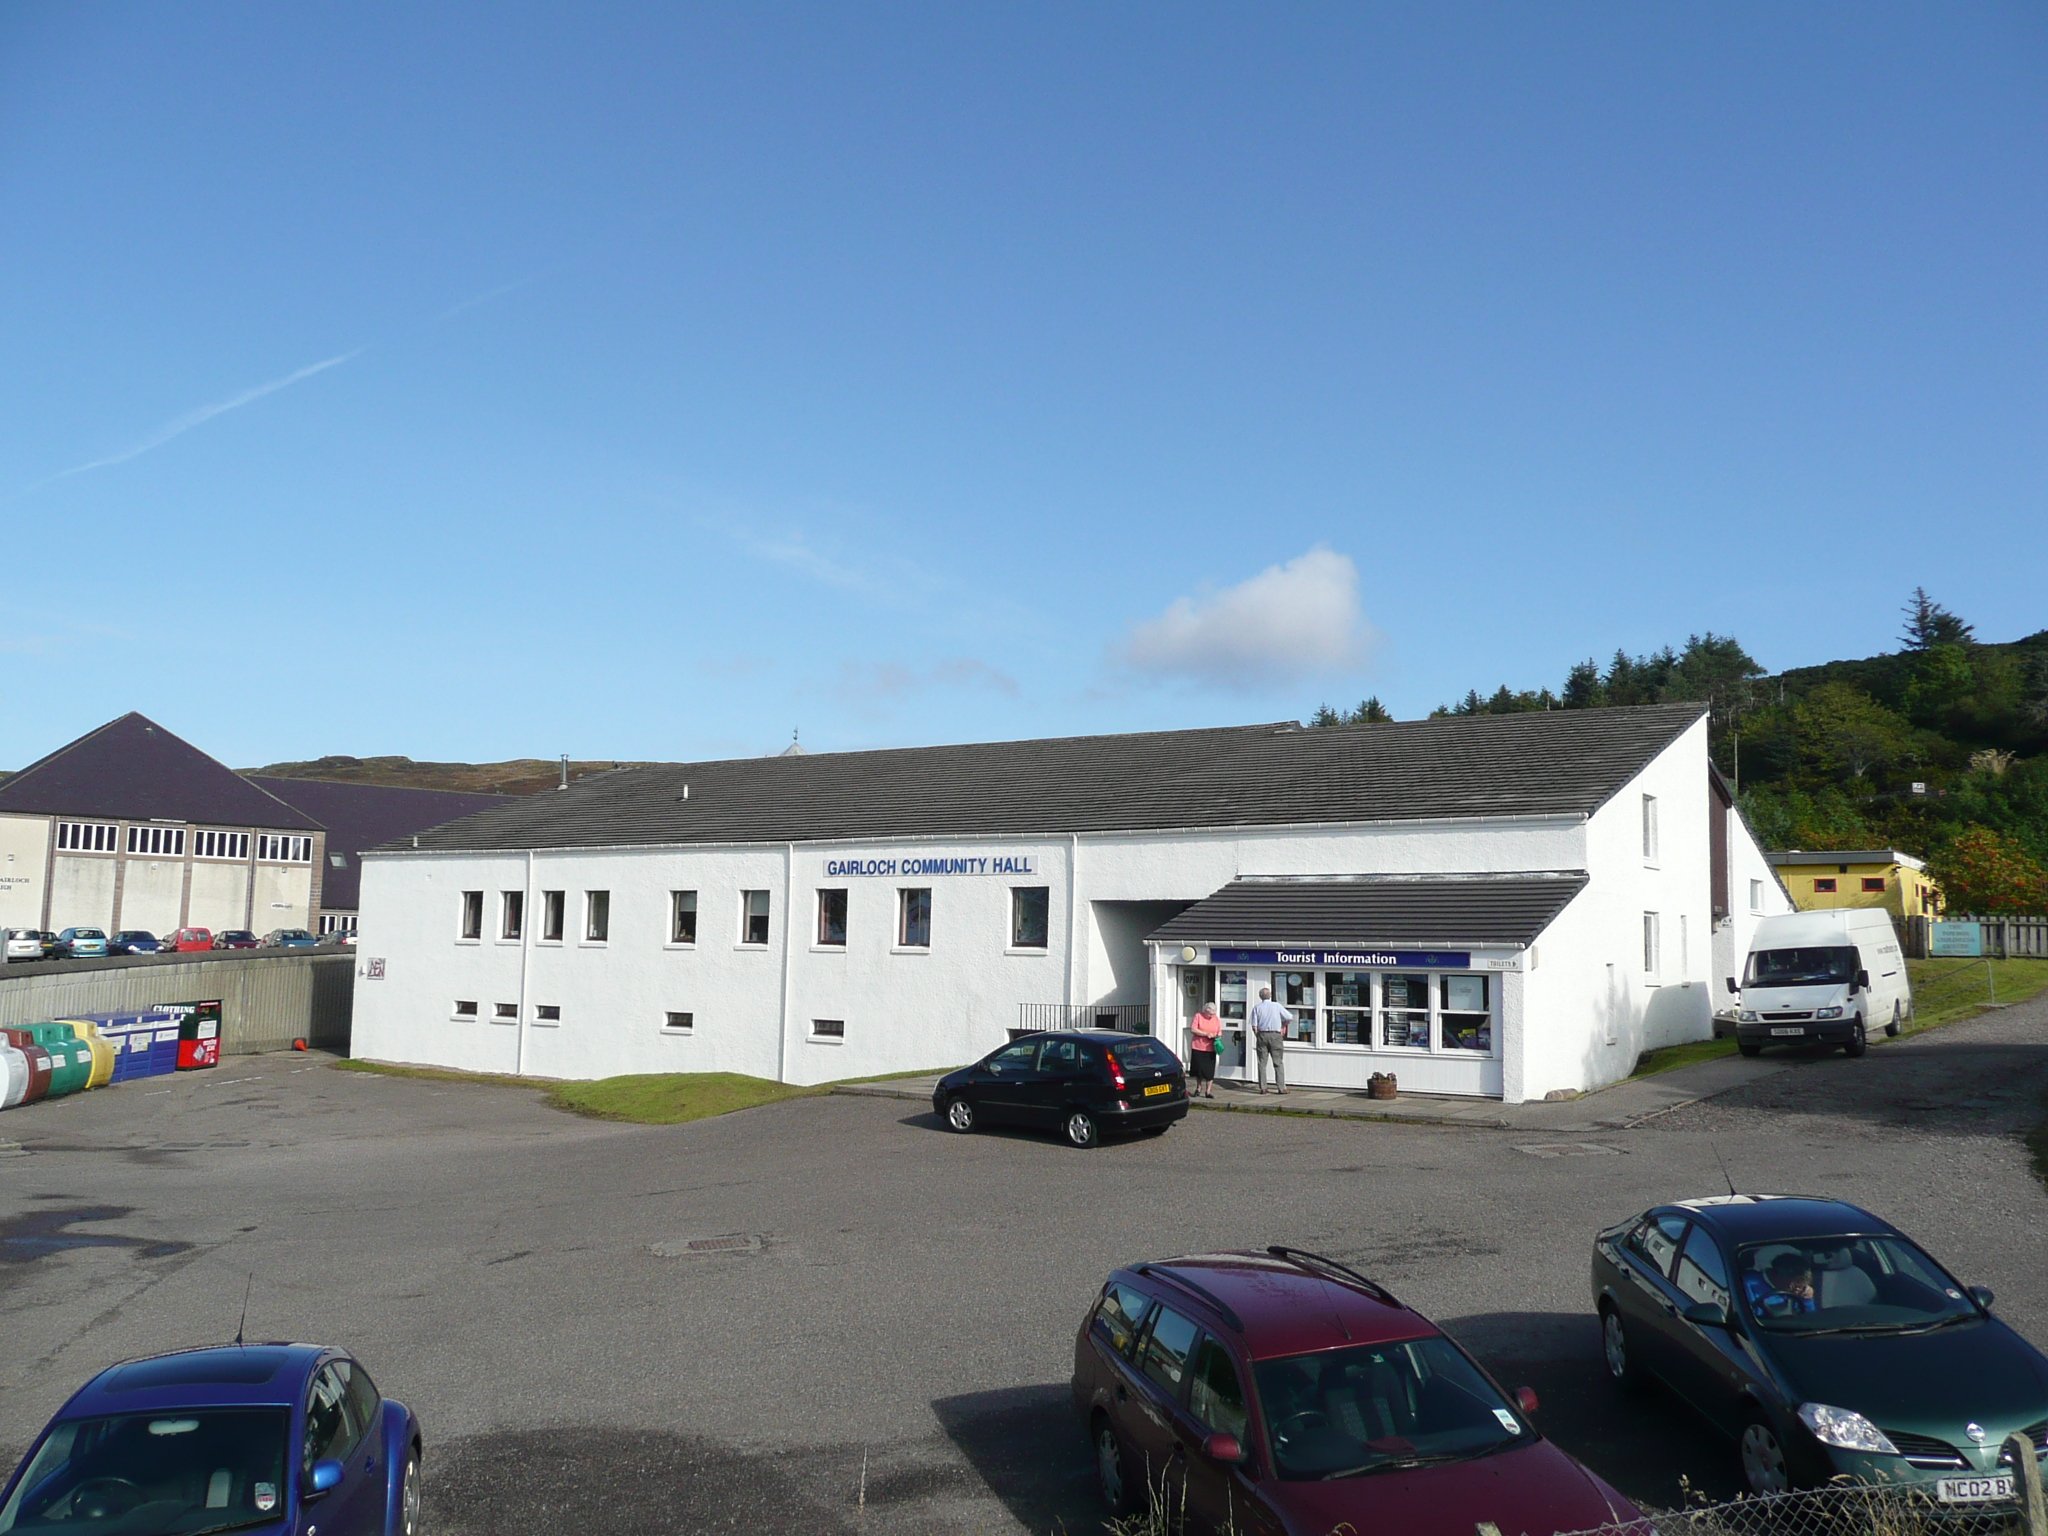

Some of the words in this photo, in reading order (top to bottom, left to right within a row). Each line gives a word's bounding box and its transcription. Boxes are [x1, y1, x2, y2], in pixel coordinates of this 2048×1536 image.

[827, 860, 896, 875] GAIRLOCH
[901, 858, 987, 874] COMMUNITY
[992, 857, 1032, 873] HALL
[1276, 951, 1316, 963] Tourist
[1323, 952, 1397, 964] Information
[153, 1004, 195, 1014] CLOTHING
